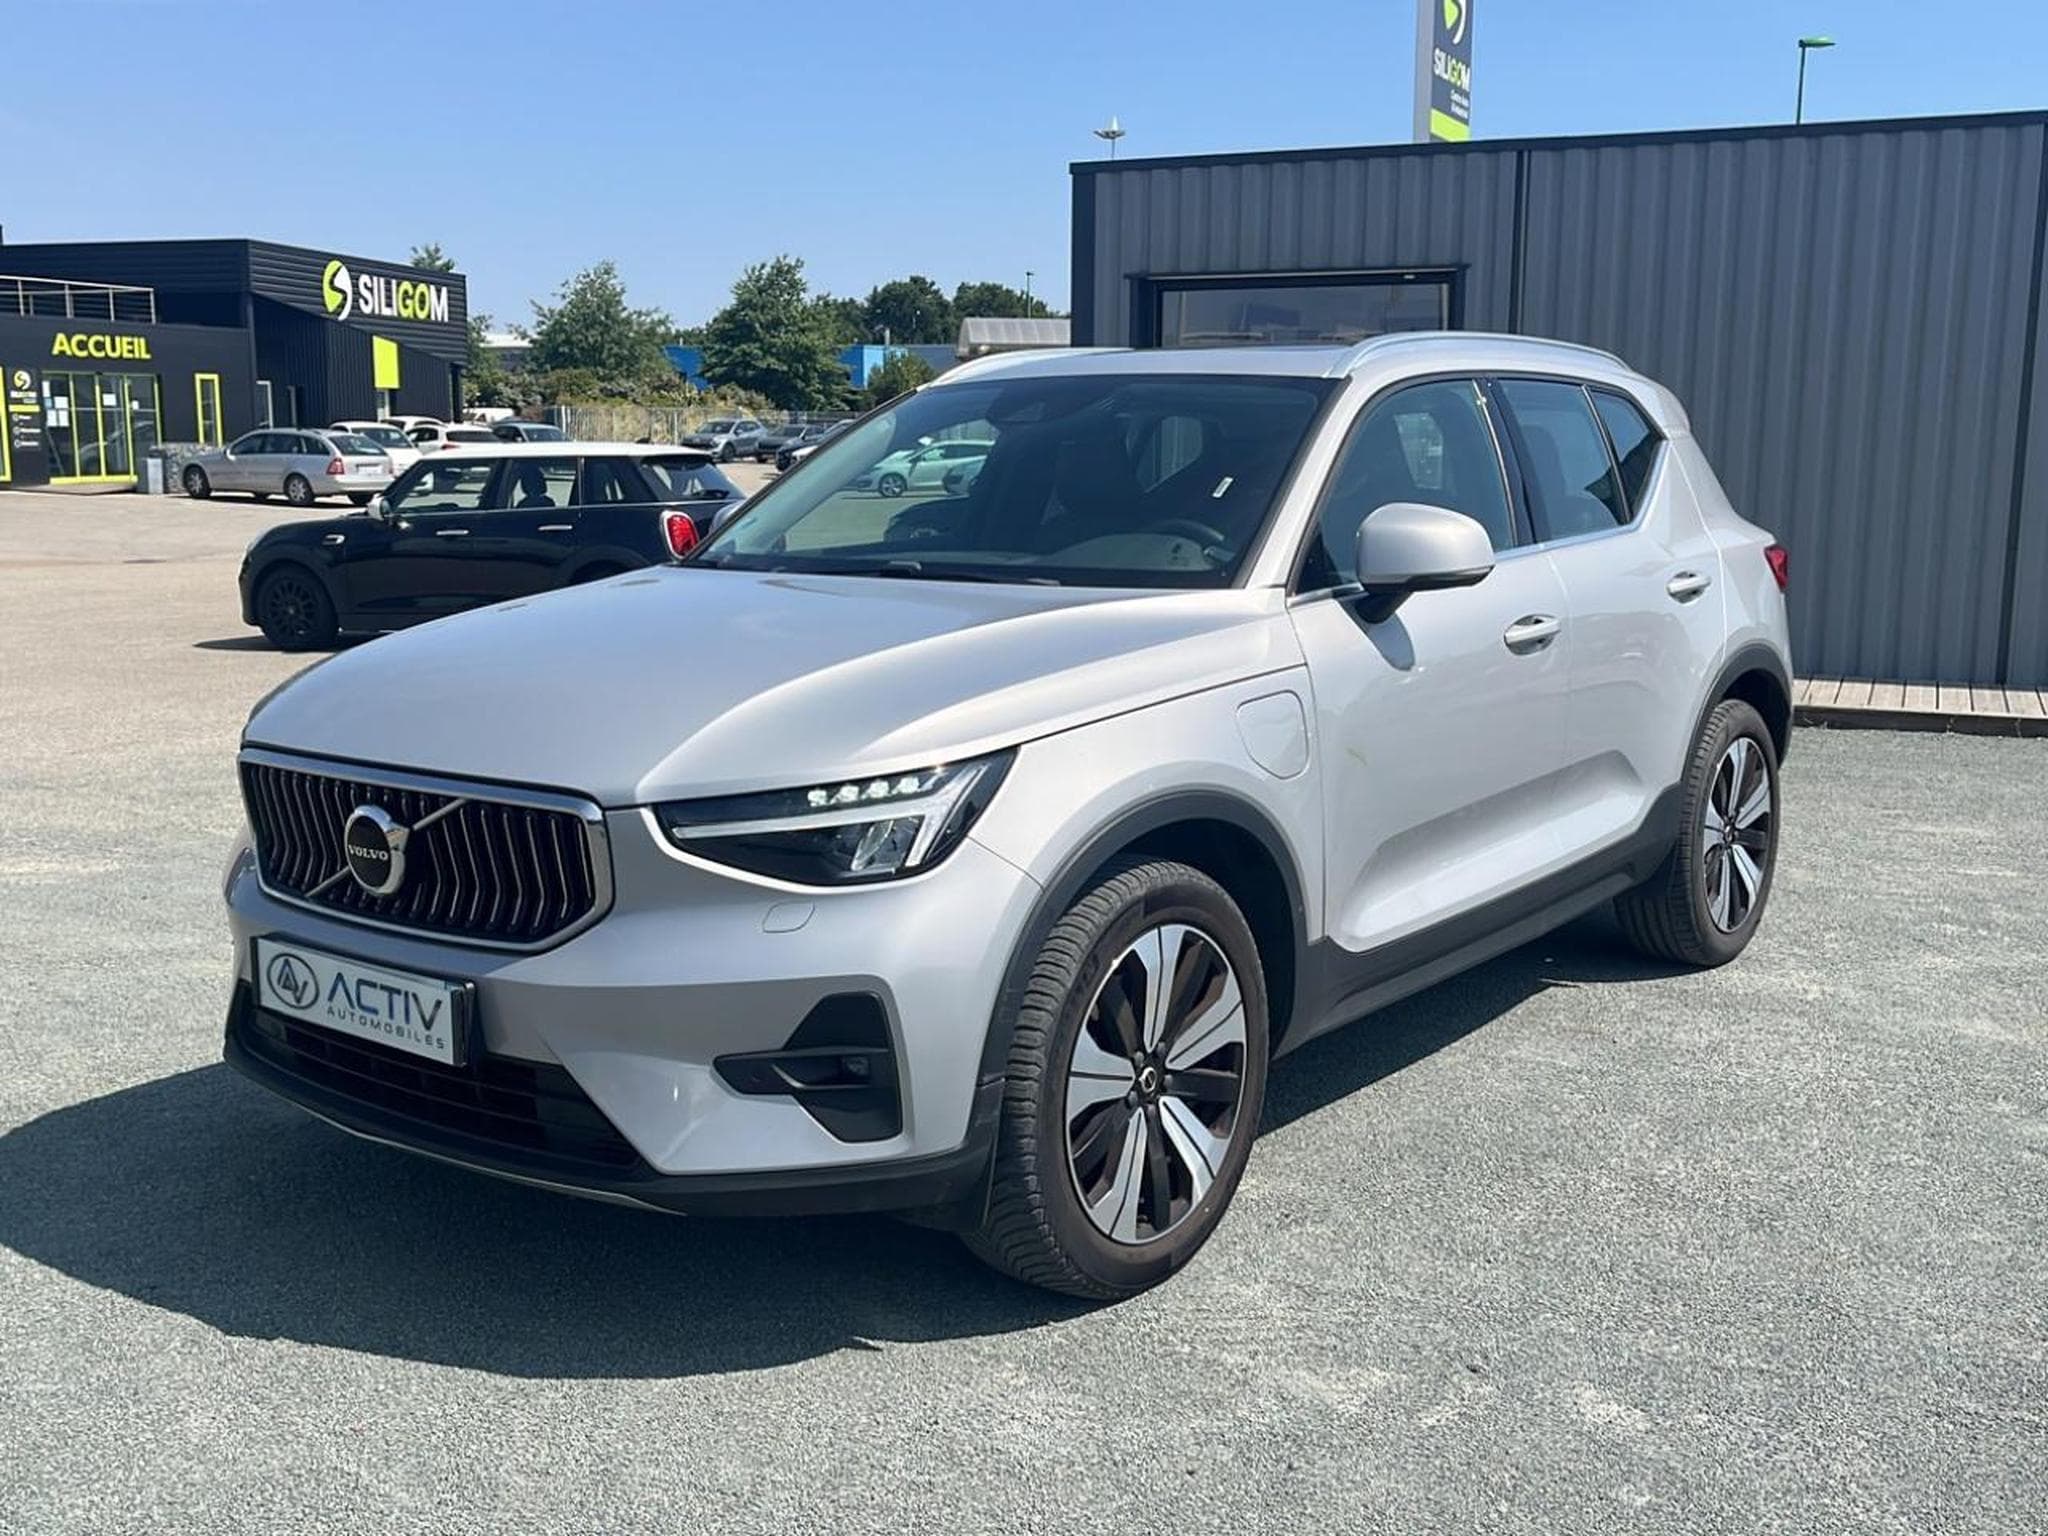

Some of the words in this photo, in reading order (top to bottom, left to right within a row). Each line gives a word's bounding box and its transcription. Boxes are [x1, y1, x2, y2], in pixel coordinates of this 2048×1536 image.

[358, 273, 449, 322] SILIGOM
[51, 332, 152, 359] ACCUEIL
[348, 844, 389, 861] VOLVO
[327, 972, 442, 1031] ACTIV
[326, 1006, 445, 1050] AUTOMOBILES
